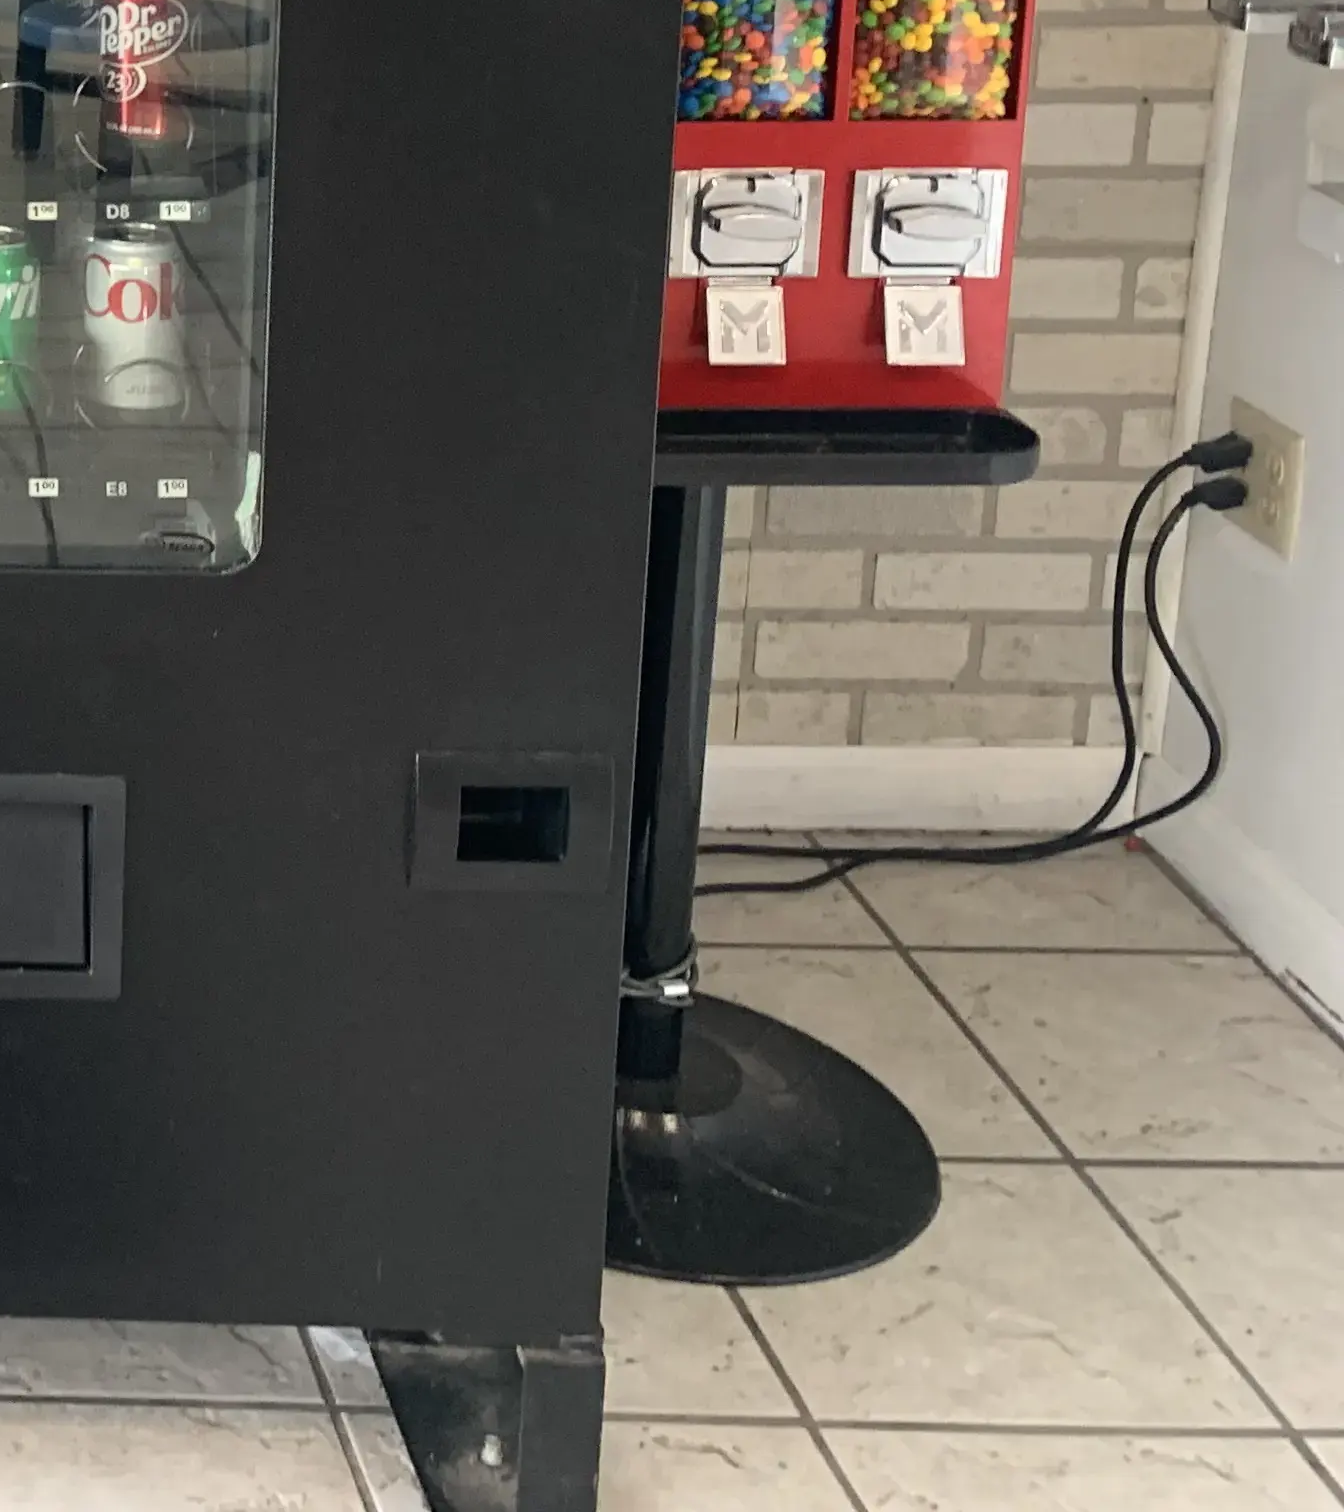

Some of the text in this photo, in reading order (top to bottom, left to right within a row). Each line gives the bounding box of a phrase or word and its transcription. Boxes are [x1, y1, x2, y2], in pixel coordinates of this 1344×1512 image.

[100, 4, 182, 58] Pepper
[118, 1, 157, 30] Dr
[106, 205, 130, 219] D8
[718, 299, 770, 355] M
[897, 298, 949, 355] M
